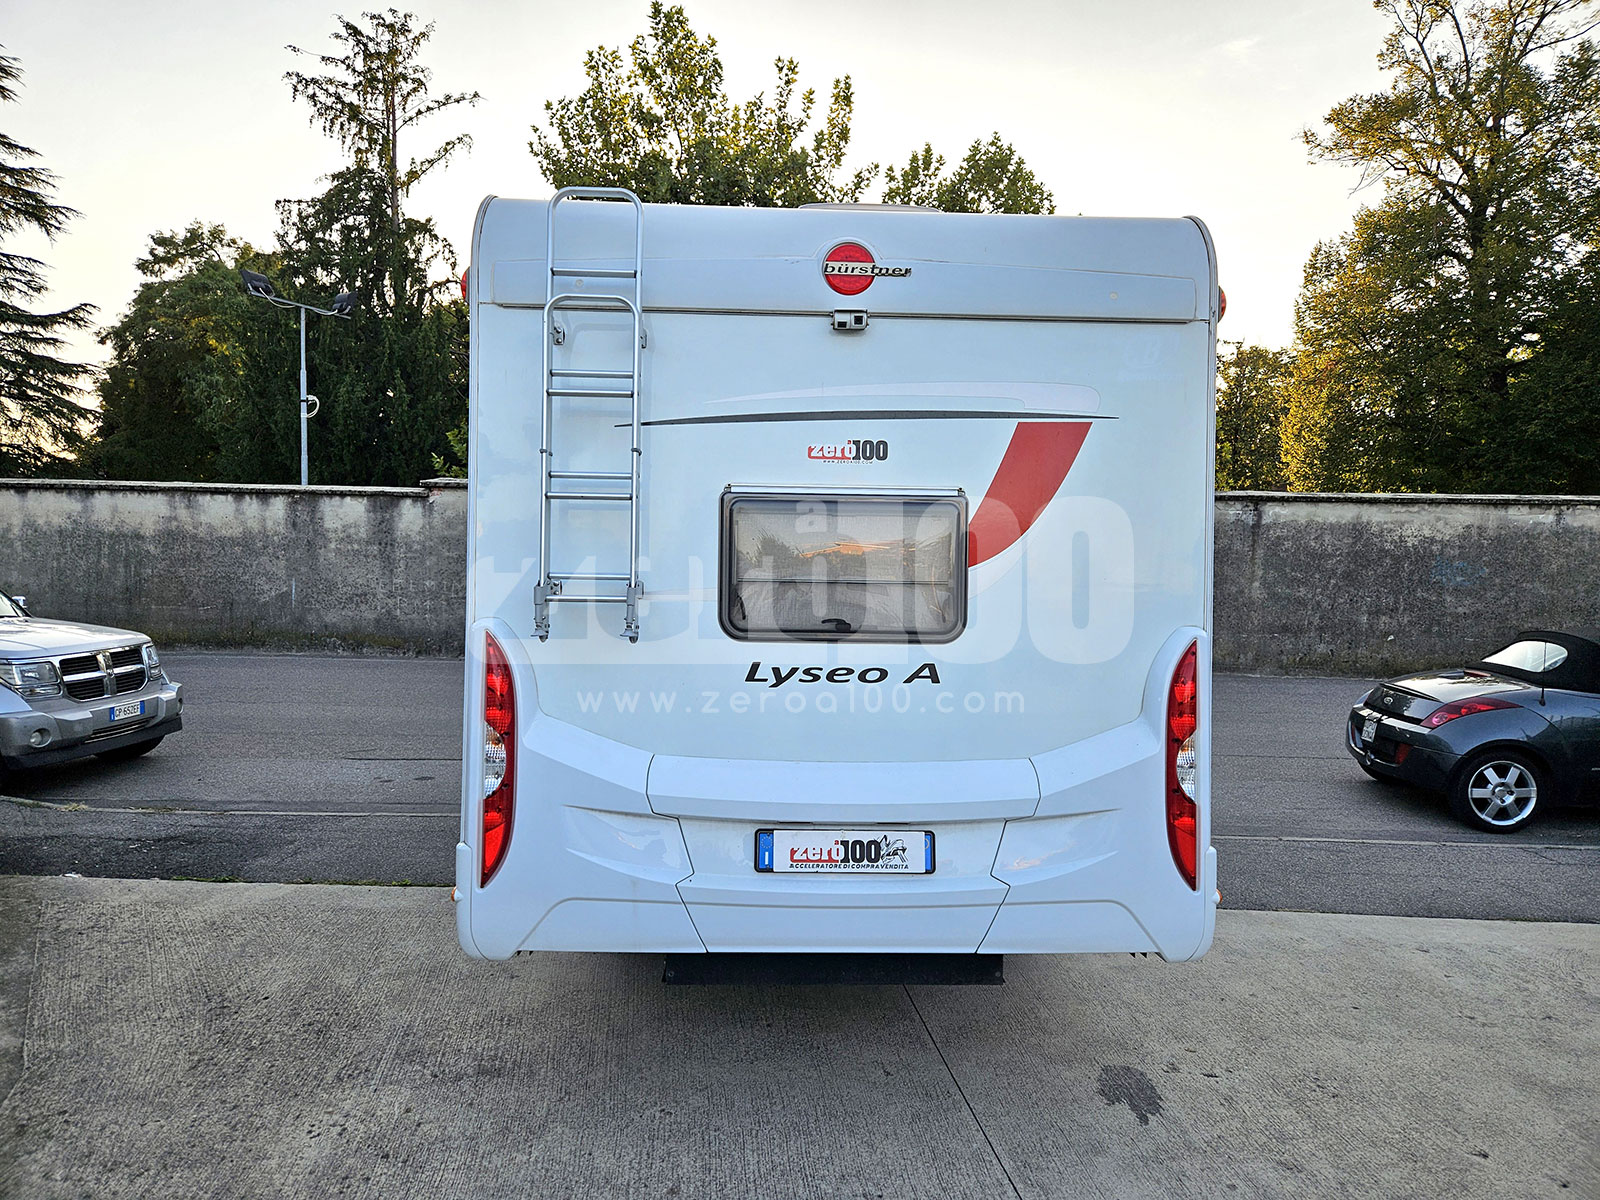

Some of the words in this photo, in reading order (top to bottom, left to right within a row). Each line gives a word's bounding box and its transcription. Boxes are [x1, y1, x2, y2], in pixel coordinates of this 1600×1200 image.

[823, 263, 912, 277] bürstner
[744, 661, 889, 688] Lyseo
[902, 662, 941, 684] A
